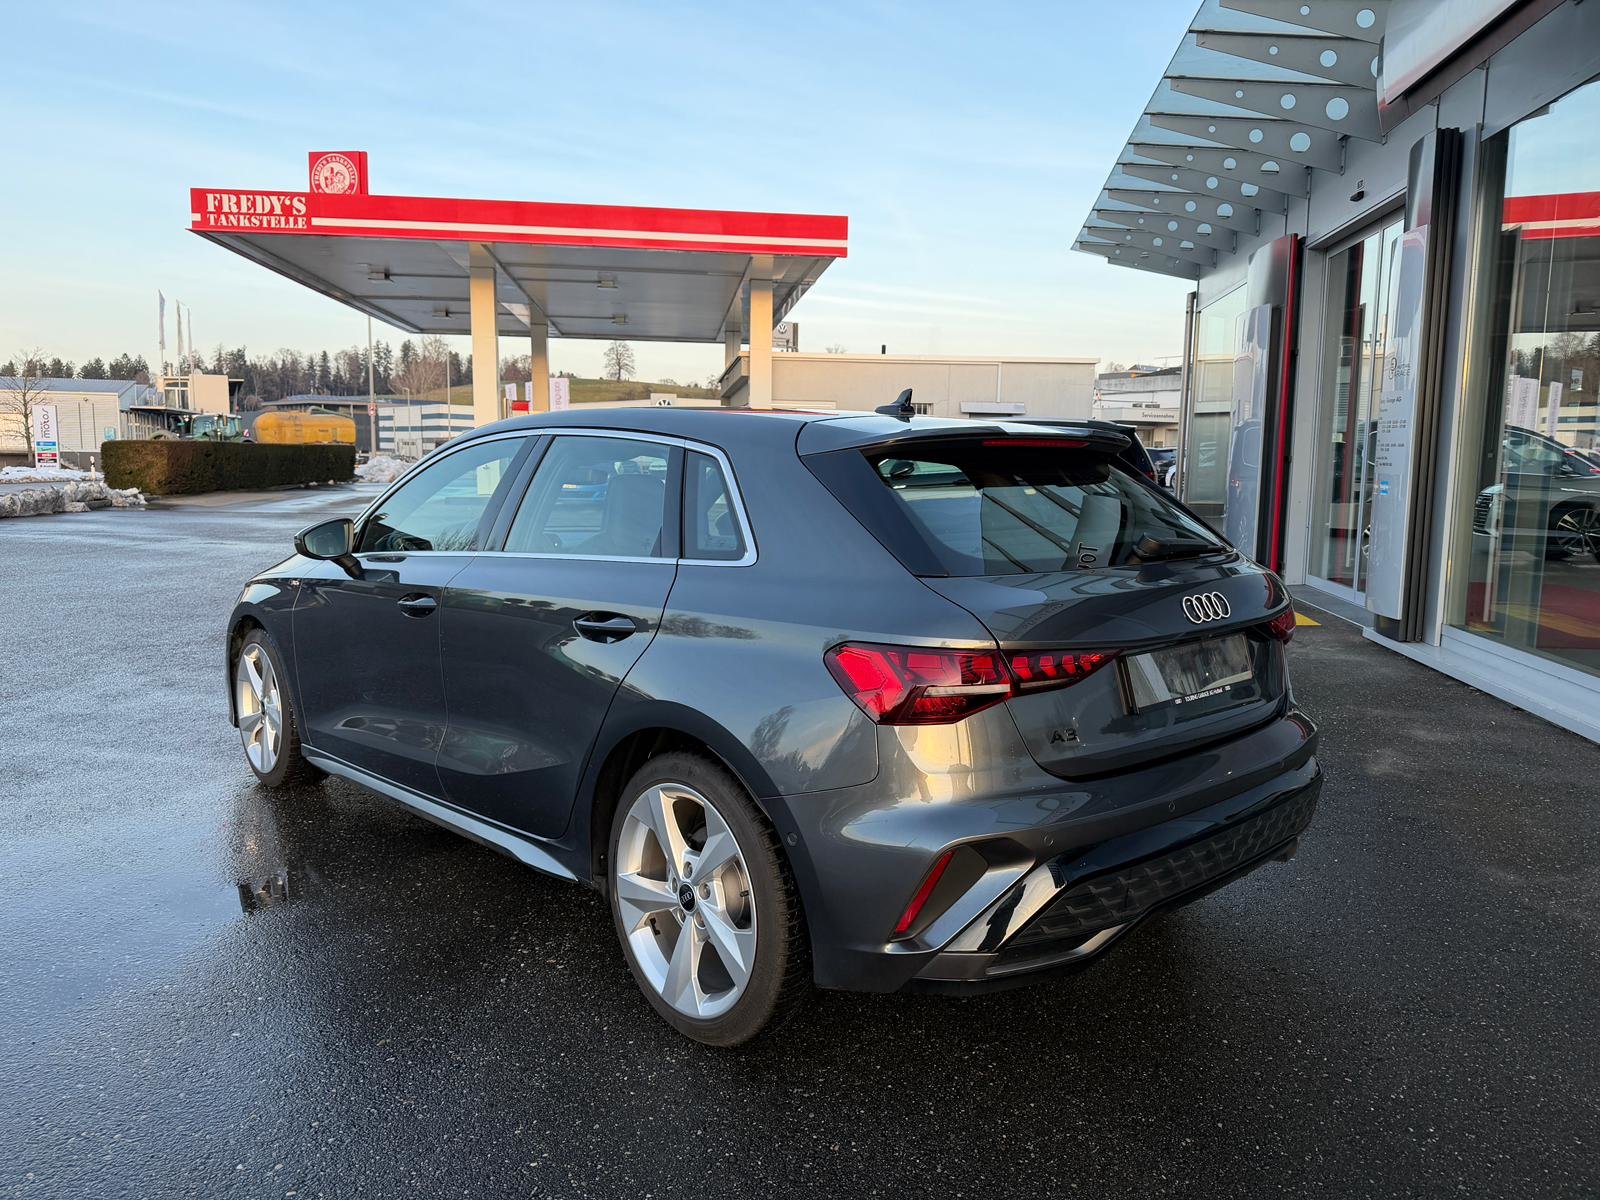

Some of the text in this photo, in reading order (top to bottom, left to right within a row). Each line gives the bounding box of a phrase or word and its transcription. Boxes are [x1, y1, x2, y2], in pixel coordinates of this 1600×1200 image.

[206, 193, 307, 215] FREDY'S
[207, 213, 307, 229] TANKSTELLE
[1050, 729, 1078, 745] A3
